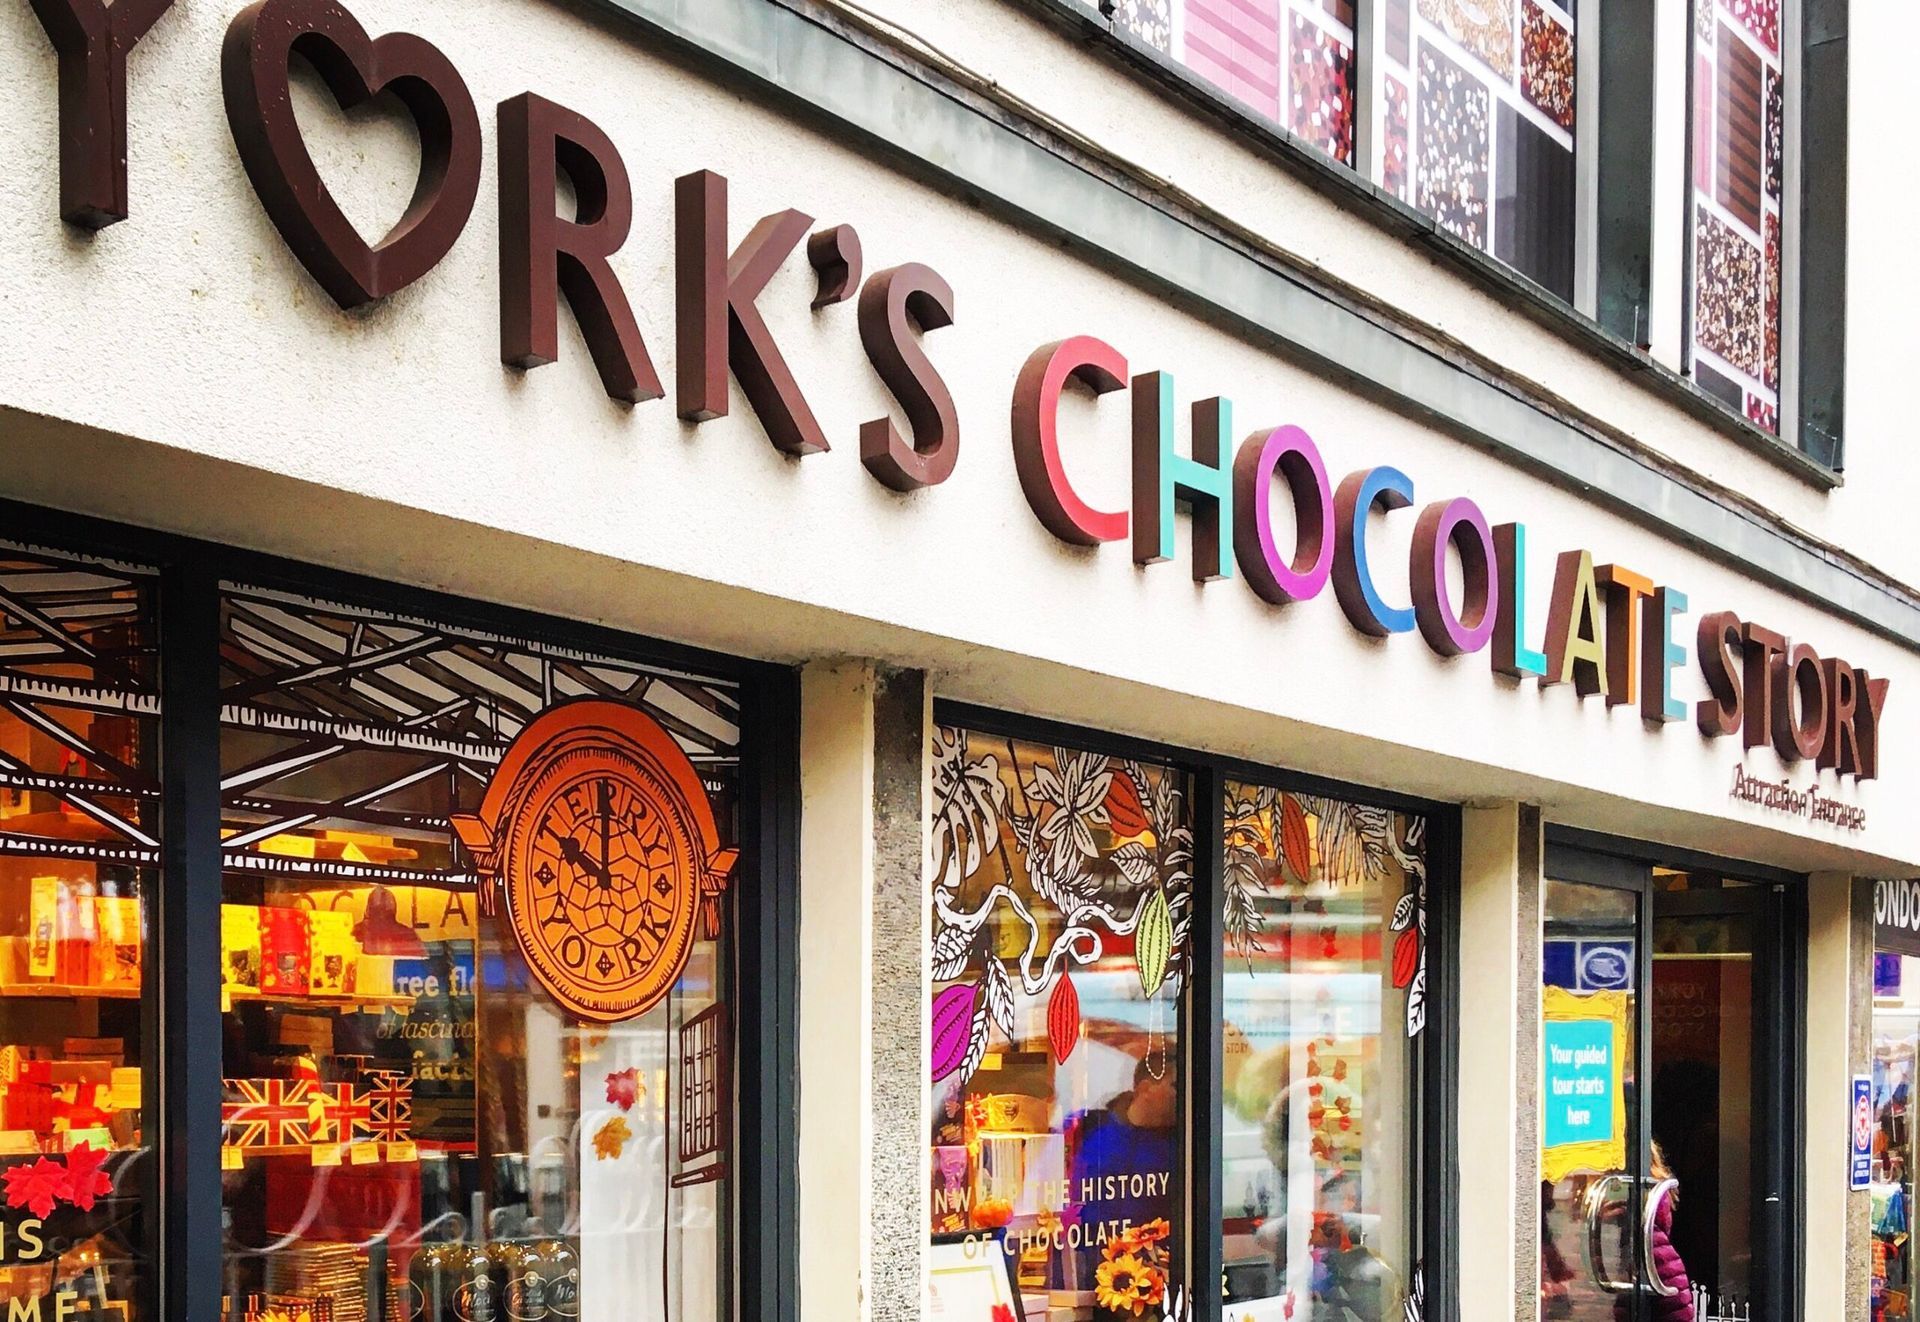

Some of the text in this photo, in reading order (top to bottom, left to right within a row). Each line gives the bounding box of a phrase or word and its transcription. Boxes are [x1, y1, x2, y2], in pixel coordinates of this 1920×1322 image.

[1011, 335, 1687, 722] CHOCOLATE
[1697, 611, 1889, 783] STORY
[1731, 762, 1867, 831] Attraction Entrance
[541, 893, 671, 975] YORK
[1550, 1043, 1607, 1070] Your guided
[1552, 1076, 1605, 1095] tour starts
[1567, 1105, 1591, 1125] here
[1034, 1179, 1071, 1205] THE
[1081, 1172, 1170, 1203] HISTORY
[963, 1232, 993, 1260] OF
[1003, 1218, 1132, 1256] CHOCOLATE
